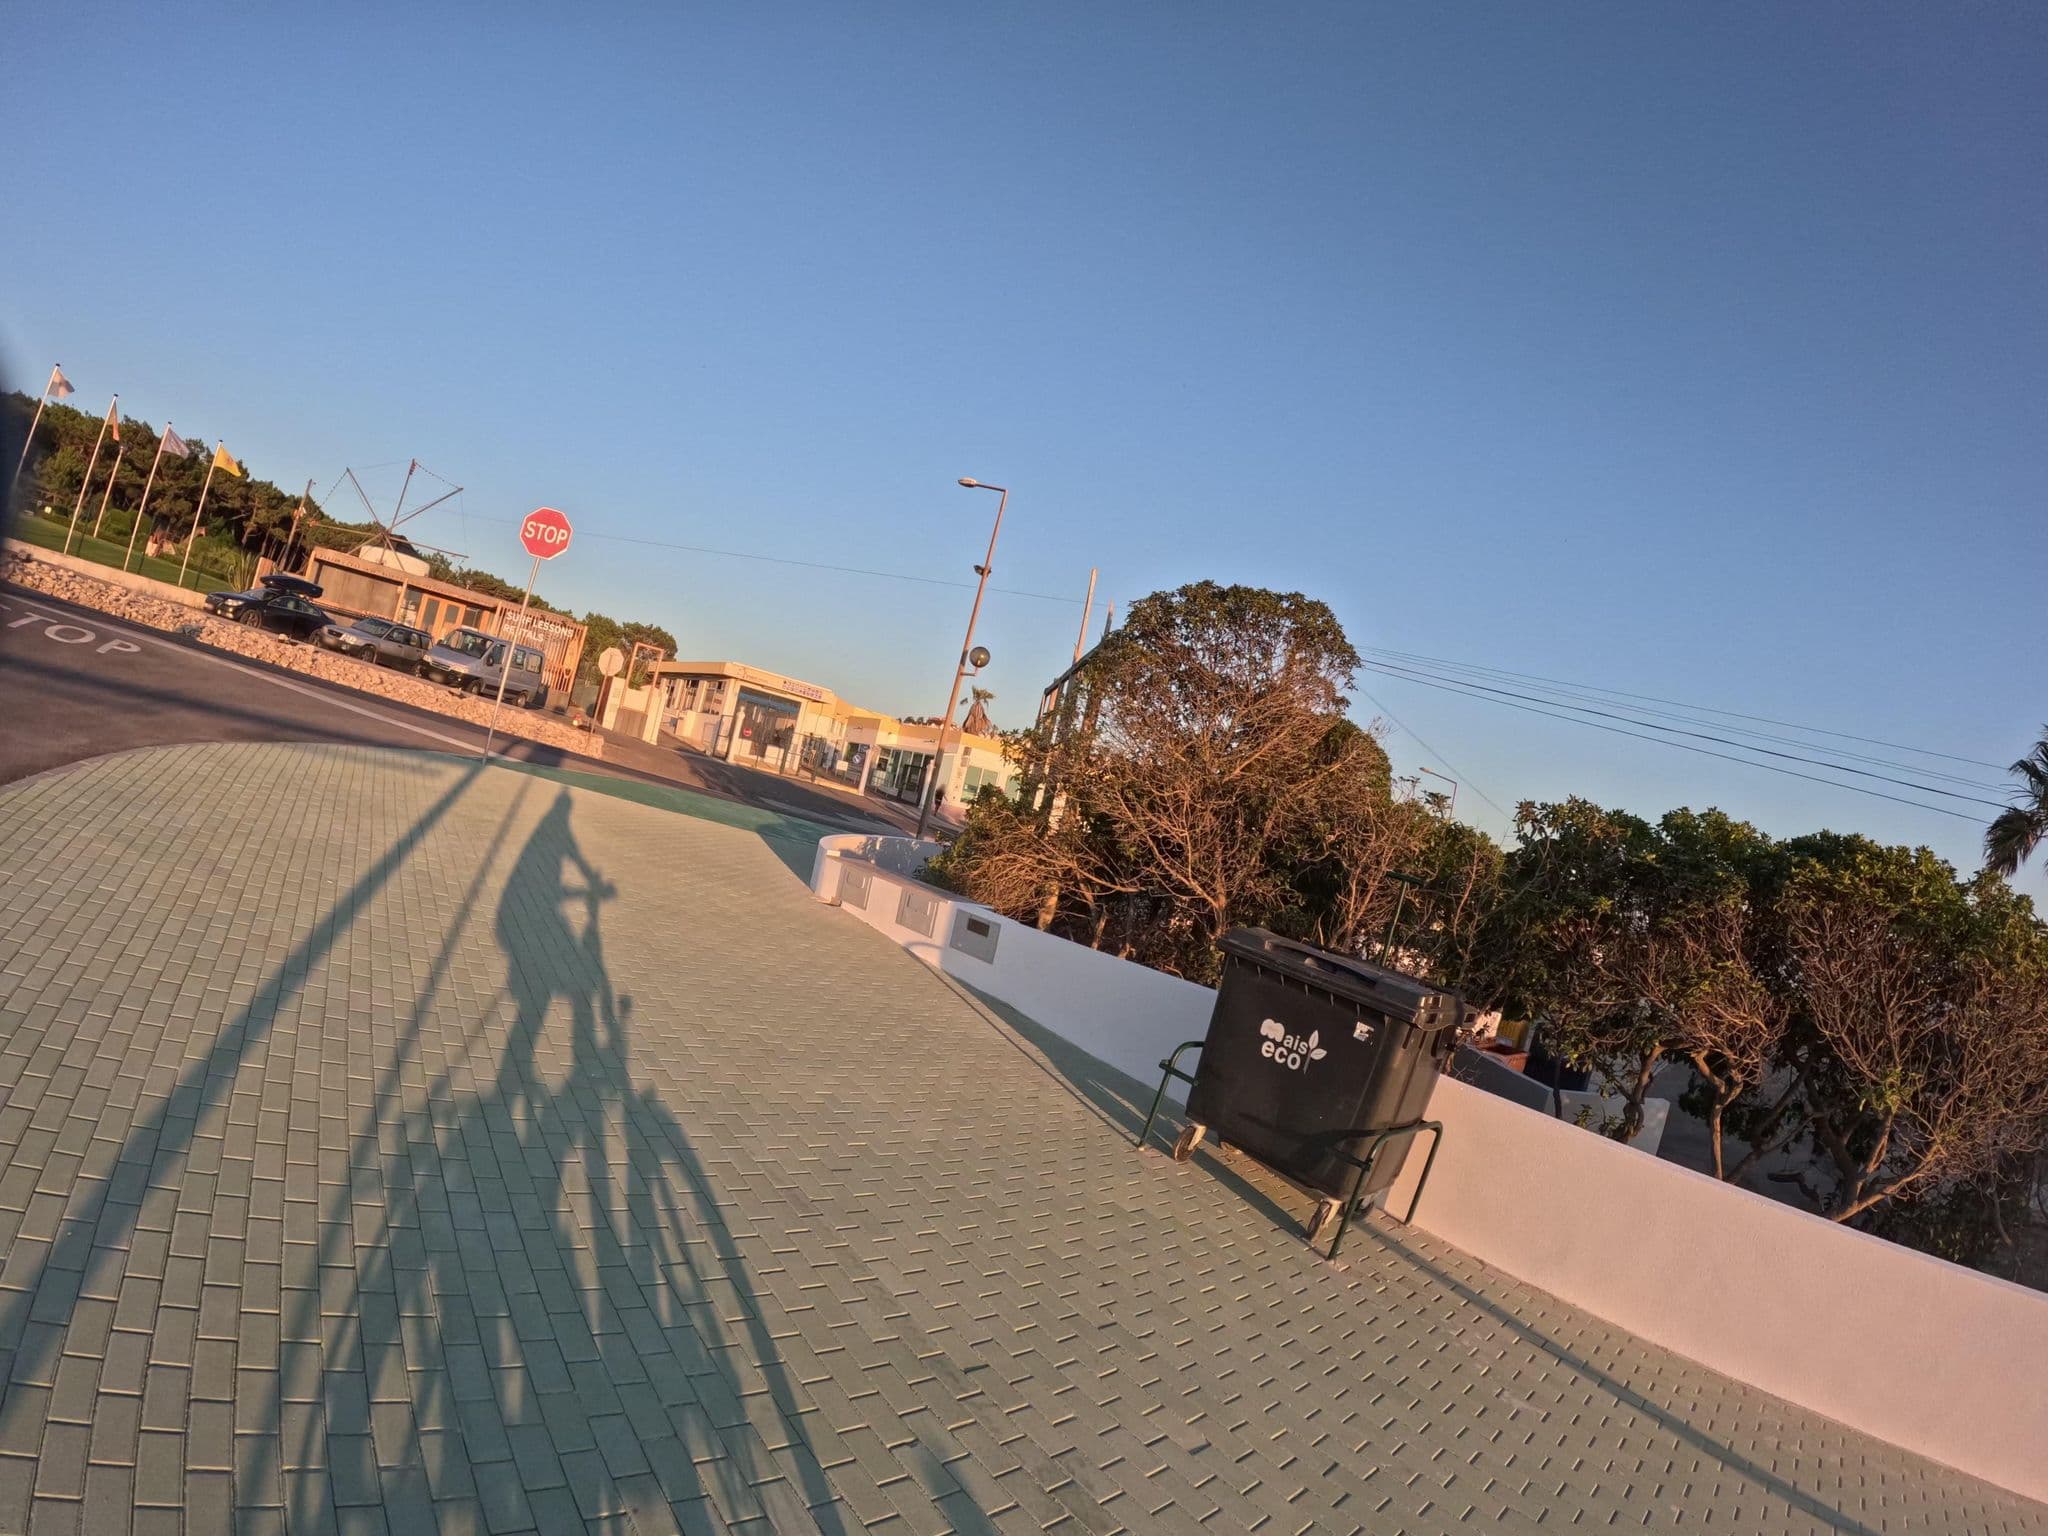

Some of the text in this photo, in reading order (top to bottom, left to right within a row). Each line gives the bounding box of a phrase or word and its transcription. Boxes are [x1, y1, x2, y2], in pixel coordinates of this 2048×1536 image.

[524, 520, 568, 545] STOP
[0, 604, 142, 654] TOP
[532, 618, 574, 638] LESSONS
[1261, 1040, 1301, 1070] eco
